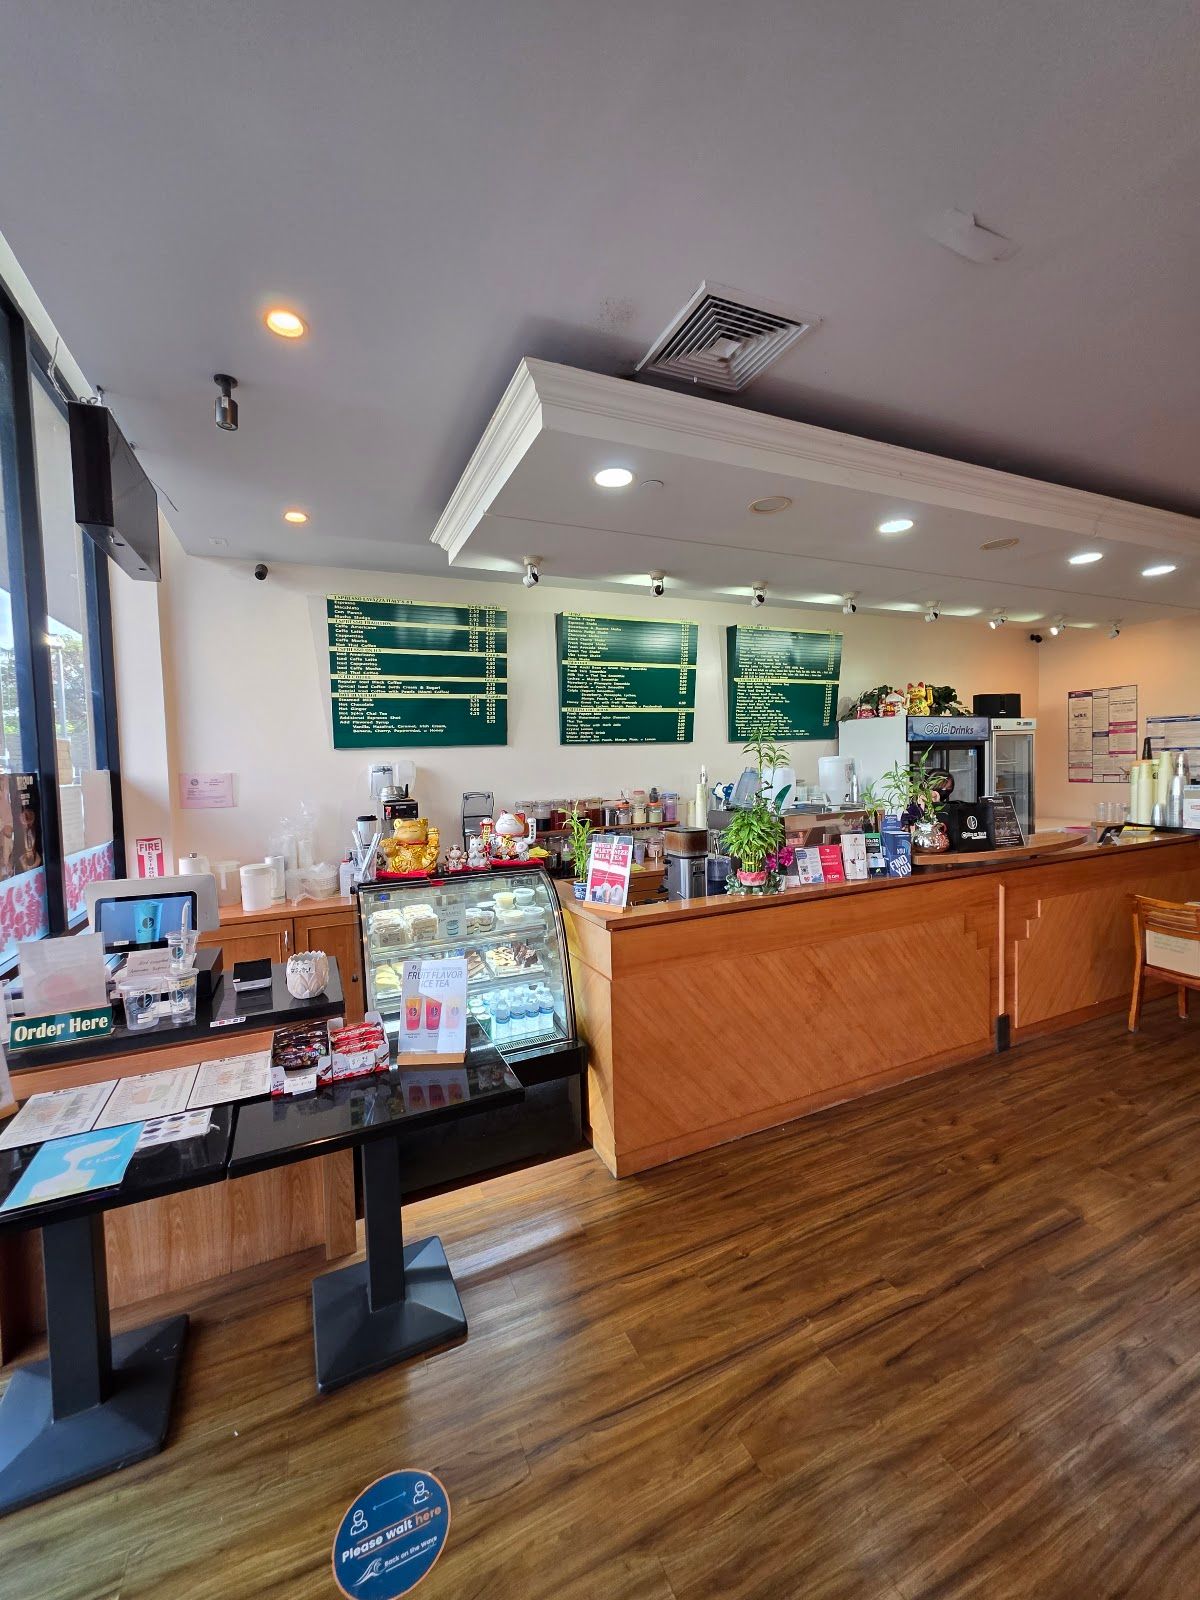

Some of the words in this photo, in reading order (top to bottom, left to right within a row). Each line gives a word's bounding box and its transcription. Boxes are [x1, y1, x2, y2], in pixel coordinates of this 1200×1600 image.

[924, 722, 950, 735] Cold
[950, 726, 974, 735] Drinks
[140, 842, 160, 852] FIRE
[890, 854, 908, 871] FIND
[896, 862, 912, 878] YOU
[408, 972, 430, 980] FRUIT
[432, 970, 462, 979] FLAVOR
[435, 980, 450, 988] TEA
[14, 1024, 65, 1042] Order
[70, 1015, 109, 1033] Here
[342, 1535, 383, 1563] Please
[386, 1519, 413, 1539] wait
[415, 1506, 442, 1526] here
[384, 1554, 400, 1567] Back
[410, 1545, 420, 1555] the
